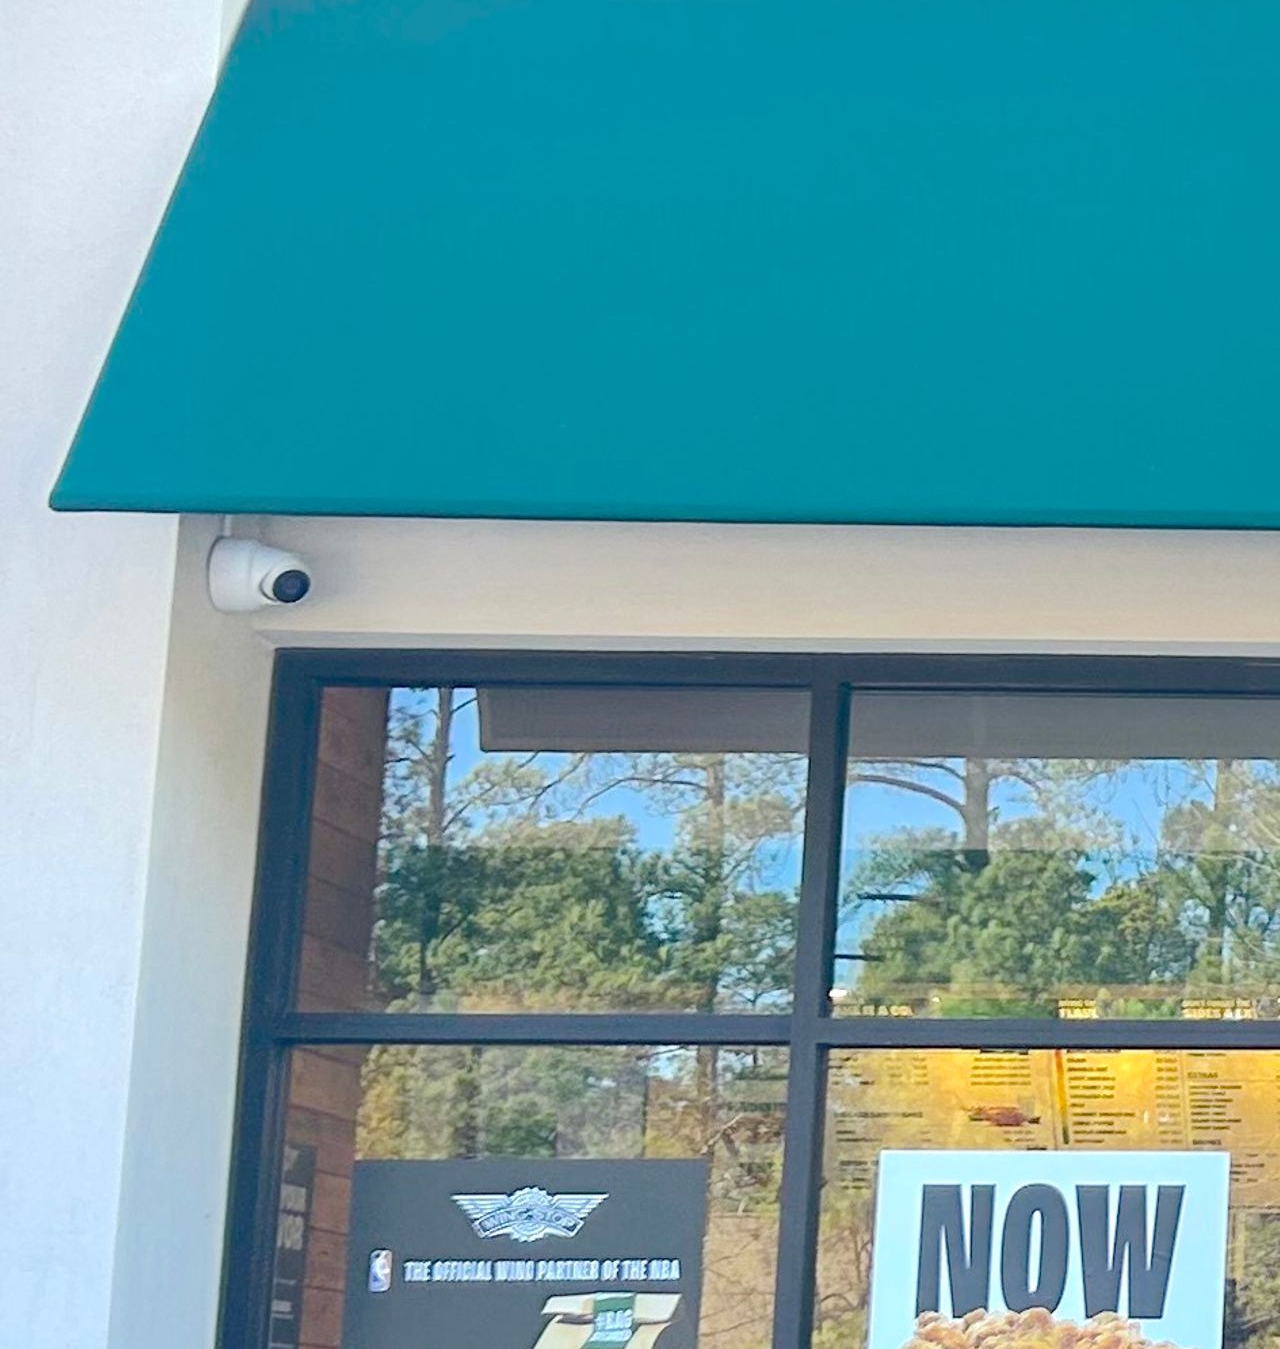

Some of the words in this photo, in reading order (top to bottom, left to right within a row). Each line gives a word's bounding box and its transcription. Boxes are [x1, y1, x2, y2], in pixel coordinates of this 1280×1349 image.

[404, 1260, 432, 1281] THE
[432, 1260, 492, 1281] OFFICIAL
[493, 1260, 535, 1281] WING
[535, 1260, 600, 1281] PARTNER
[601, 1259, 620, 1281] OF
[621, 1259, 647, 1281] THE
[648, 1259, 681, 1281] NBA
[915, 1182, 1187, 1319] NOW
